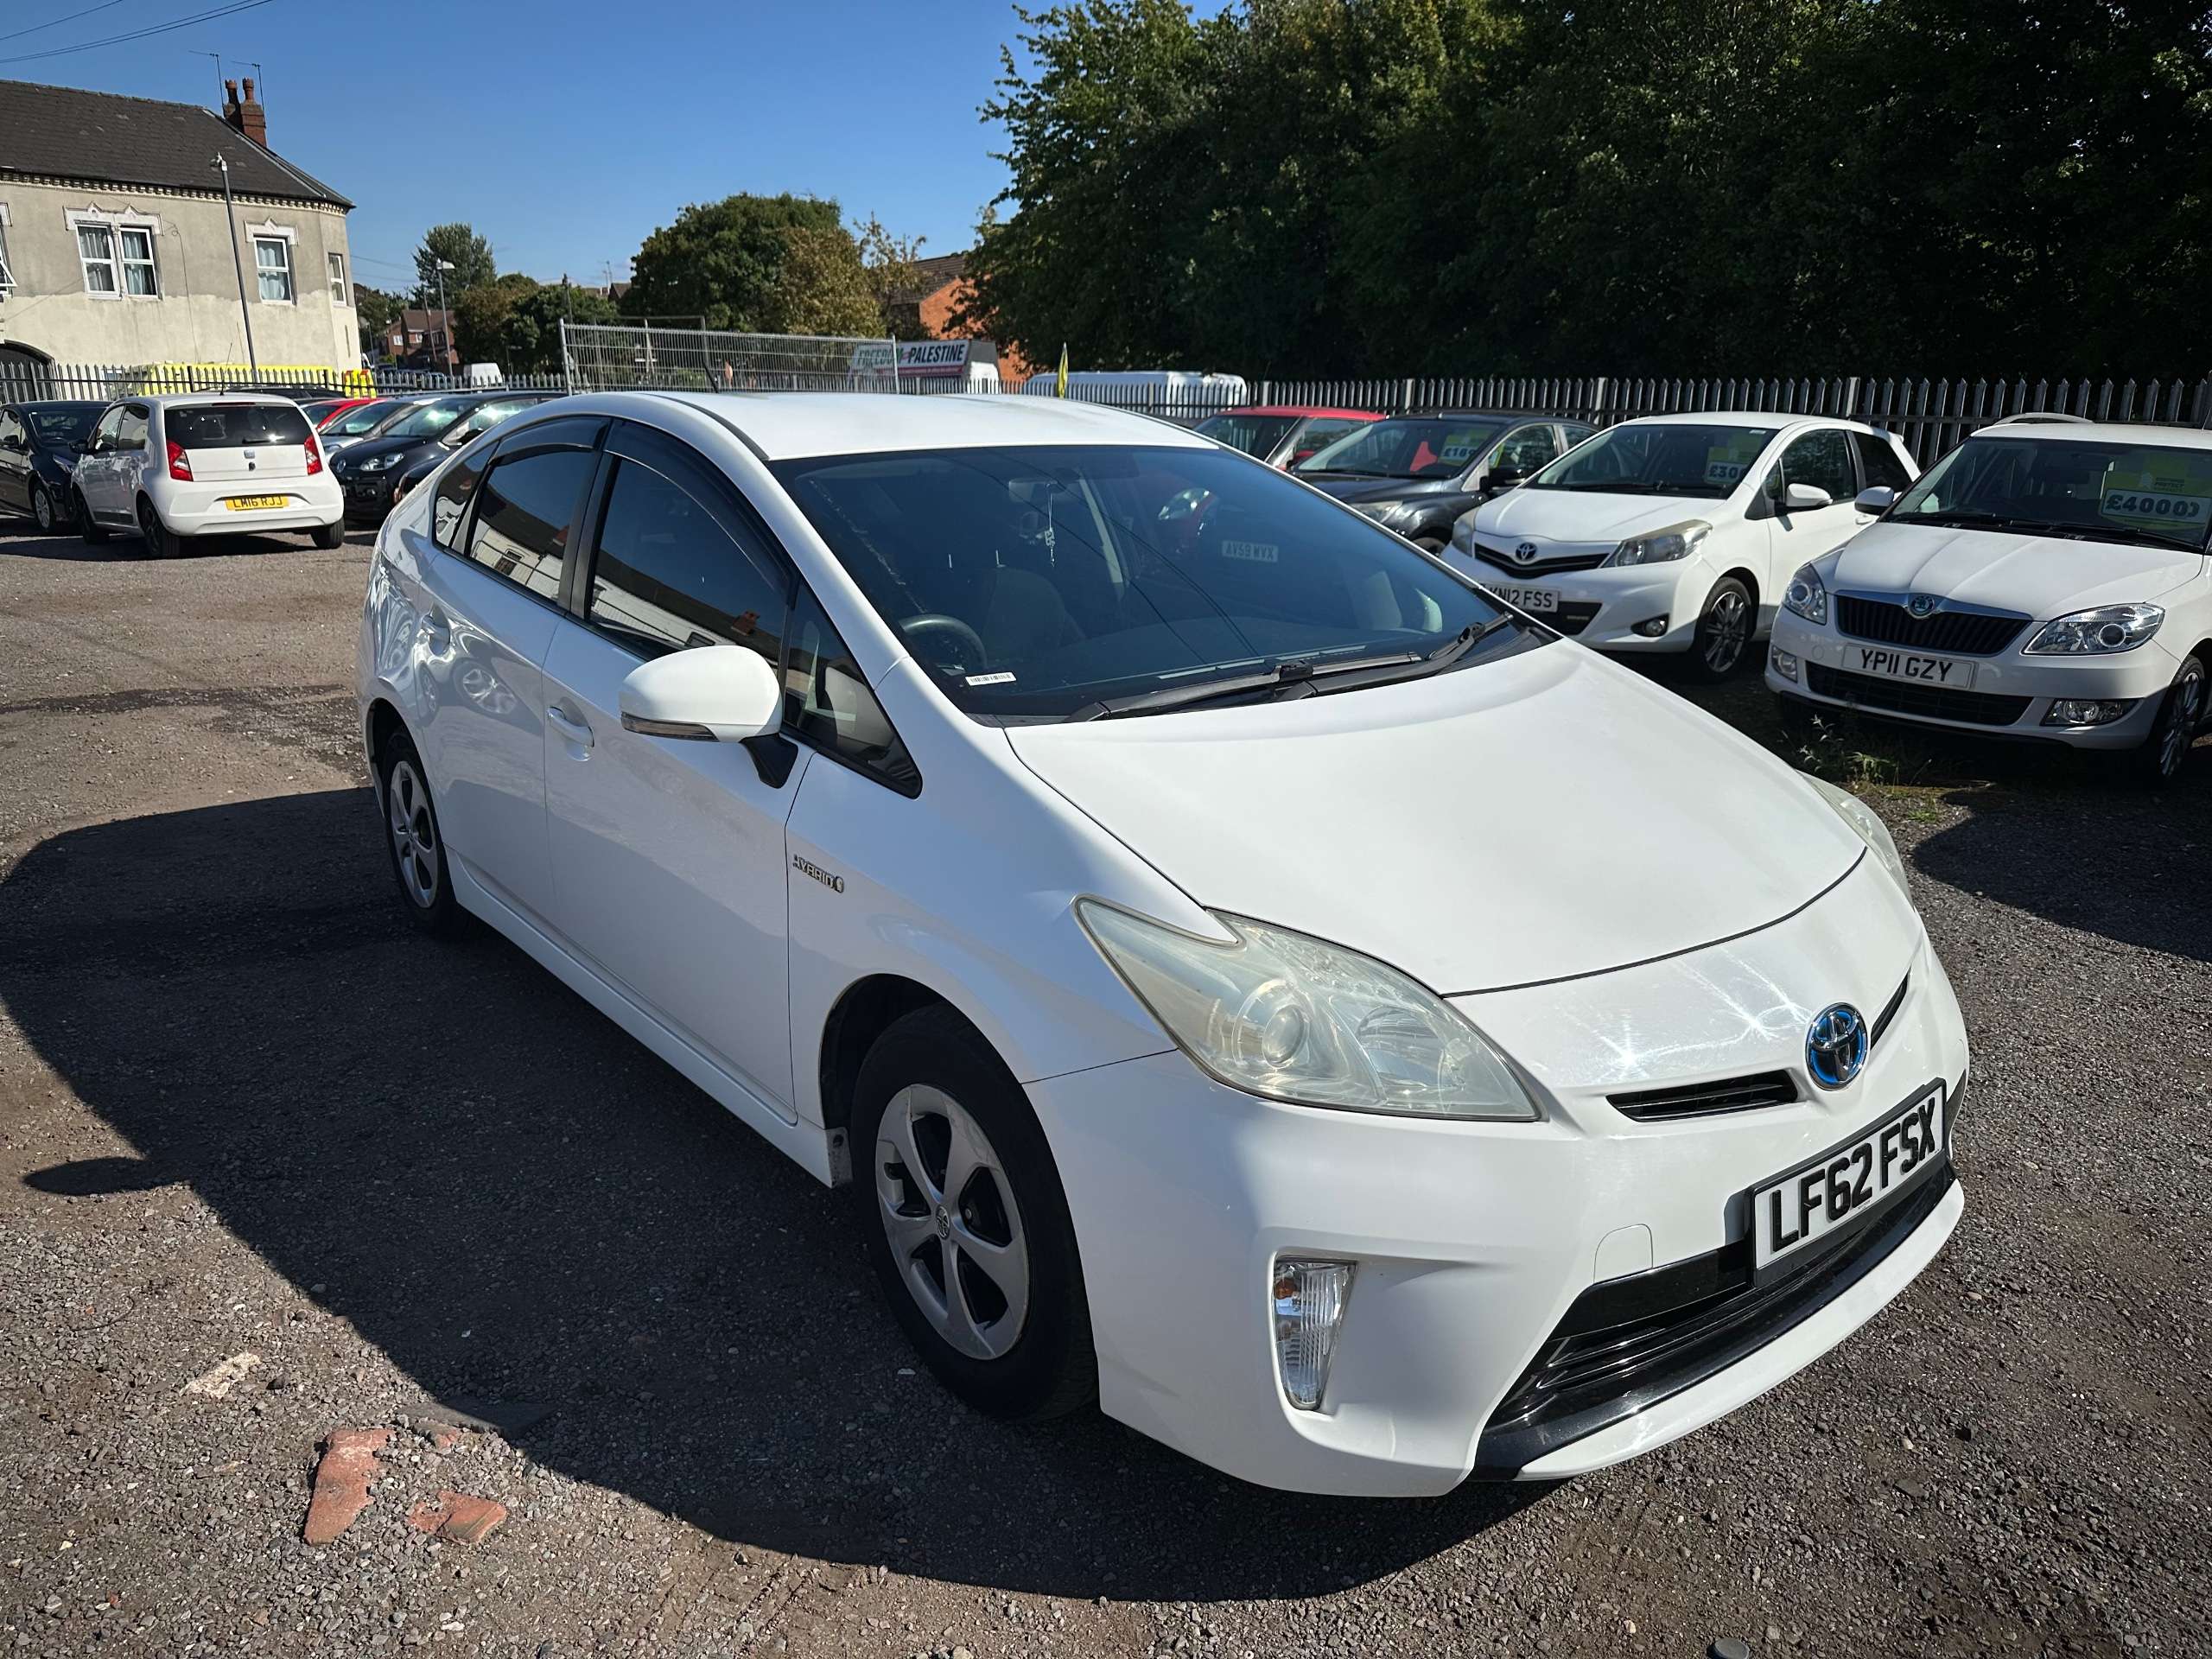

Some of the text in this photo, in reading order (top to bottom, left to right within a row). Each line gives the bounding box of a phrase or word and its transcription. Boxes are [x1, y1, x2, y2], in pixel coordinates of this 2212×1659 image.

[907, 344, 965, 364] PALESTINE
[233, 498, 258, 508] LM16
[1523, 590, 1553, 608] FSS
[1861, 649, 1953, 681] YP11 GZY
[792, 854, 836, 889] HYBRID
[1770, 1096, 1936, 1253] LF62 FSX
